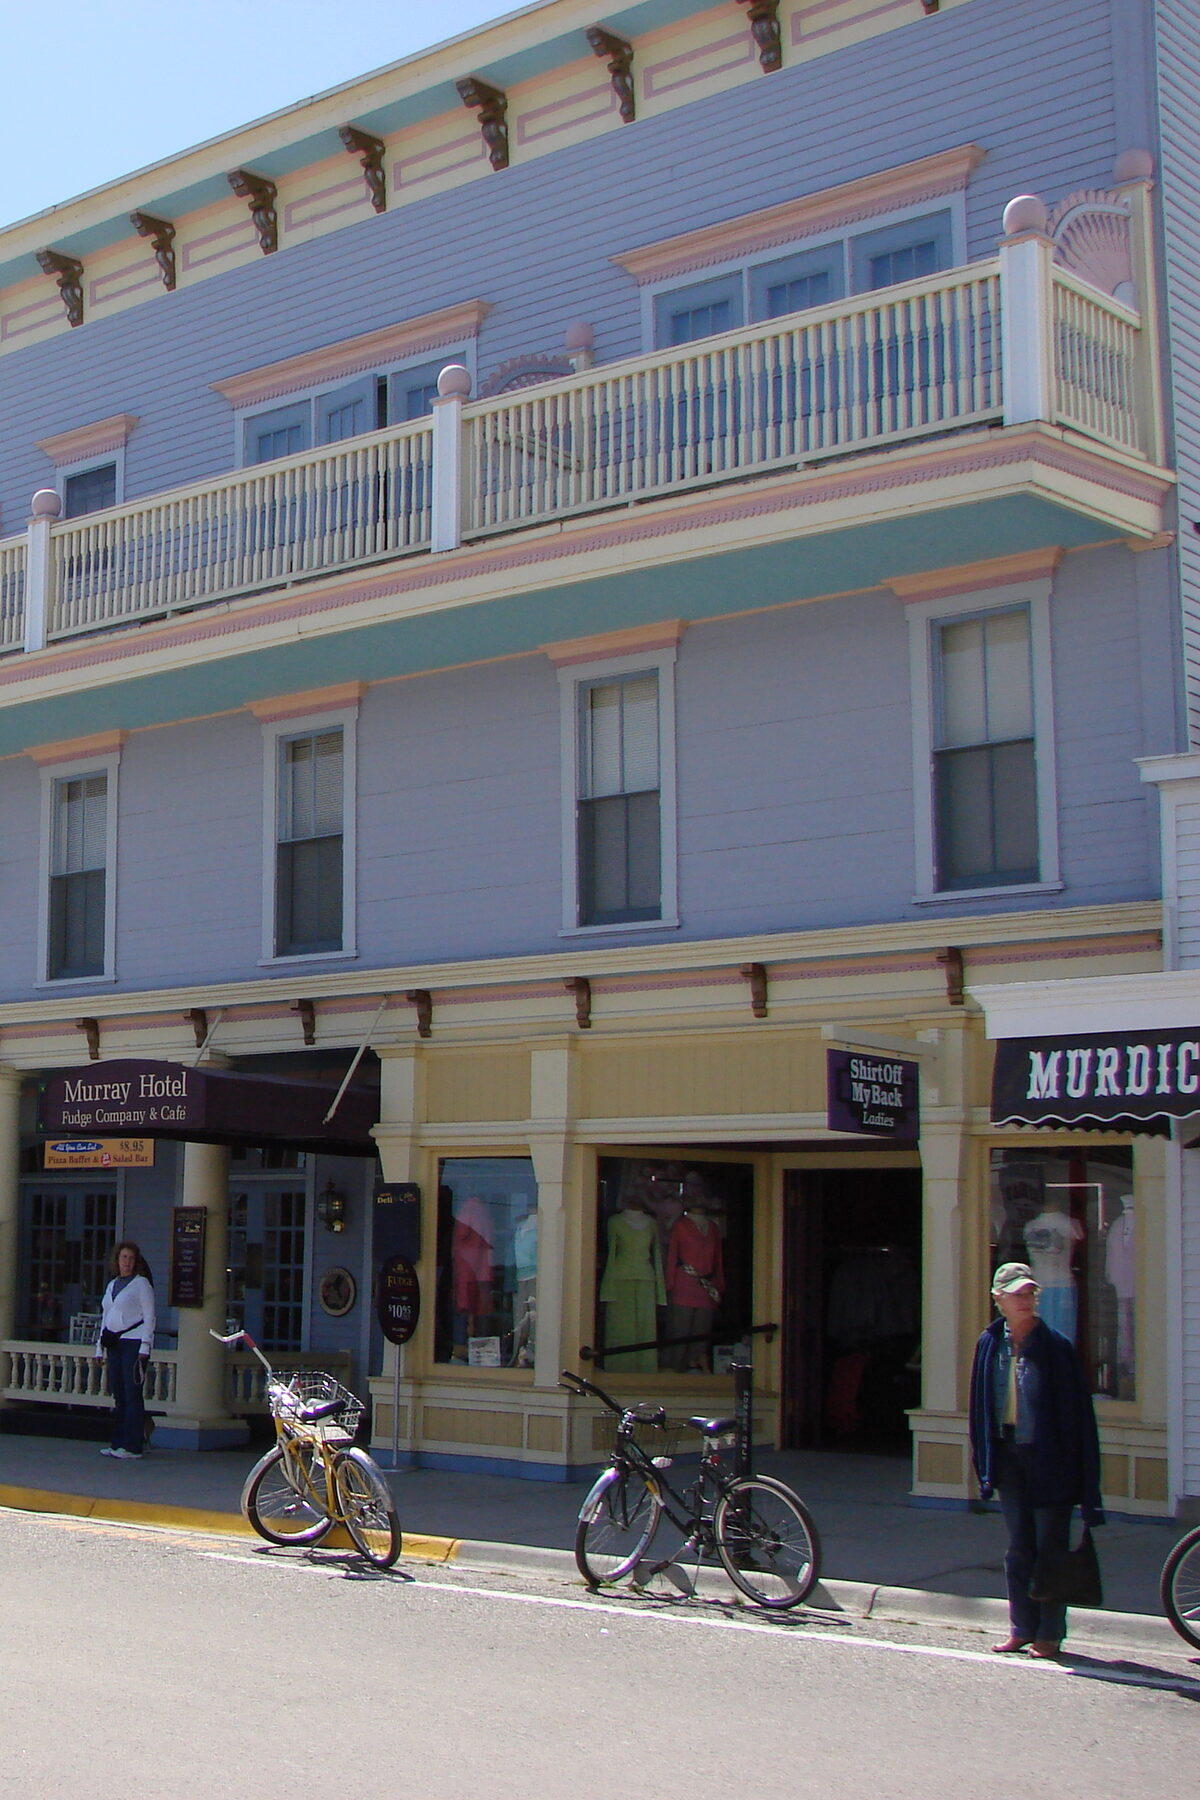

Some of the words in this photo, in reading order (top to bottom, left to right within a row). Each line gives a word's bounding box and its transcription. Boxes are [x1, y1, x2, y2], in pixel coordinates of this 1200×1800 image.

[64, 1079, 132, 1105] Murray
[139, 1071, 188, 1098] Hotel
[62, 1109, 92, 1127] Fudge
[95, 1108, 146, 1126] Company
[149, 1107, 157, 1120] &
[160, 1104, 187, 1121] Café
[862, 1111, 894, 1127] Ladies
[48, 1156, 67, 1165] Pizza
